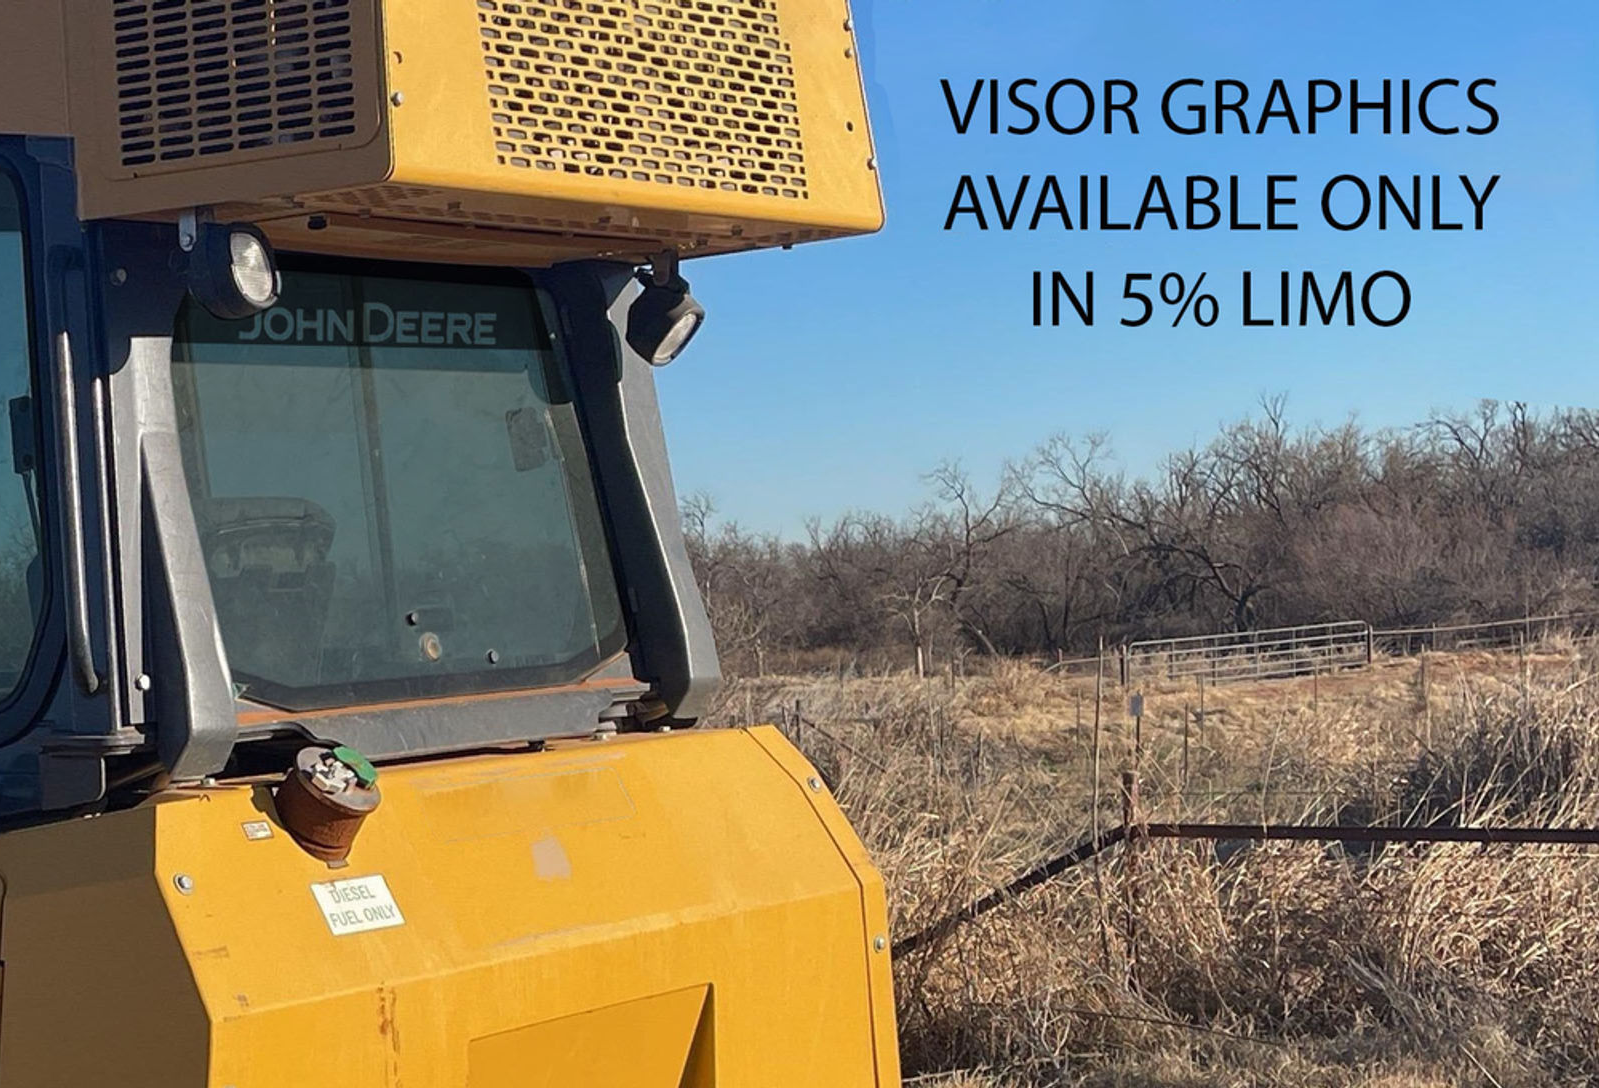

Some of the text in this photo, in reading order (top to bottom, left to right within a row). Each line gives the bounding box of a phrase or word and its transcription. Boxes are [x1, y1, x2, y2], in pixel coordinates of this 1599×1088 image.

[238, 302, 497, 345] JOHN DEERE
[329, 884, 376, 904] DIESEL
[329, 904, 396, 928] FUEL ONLY
